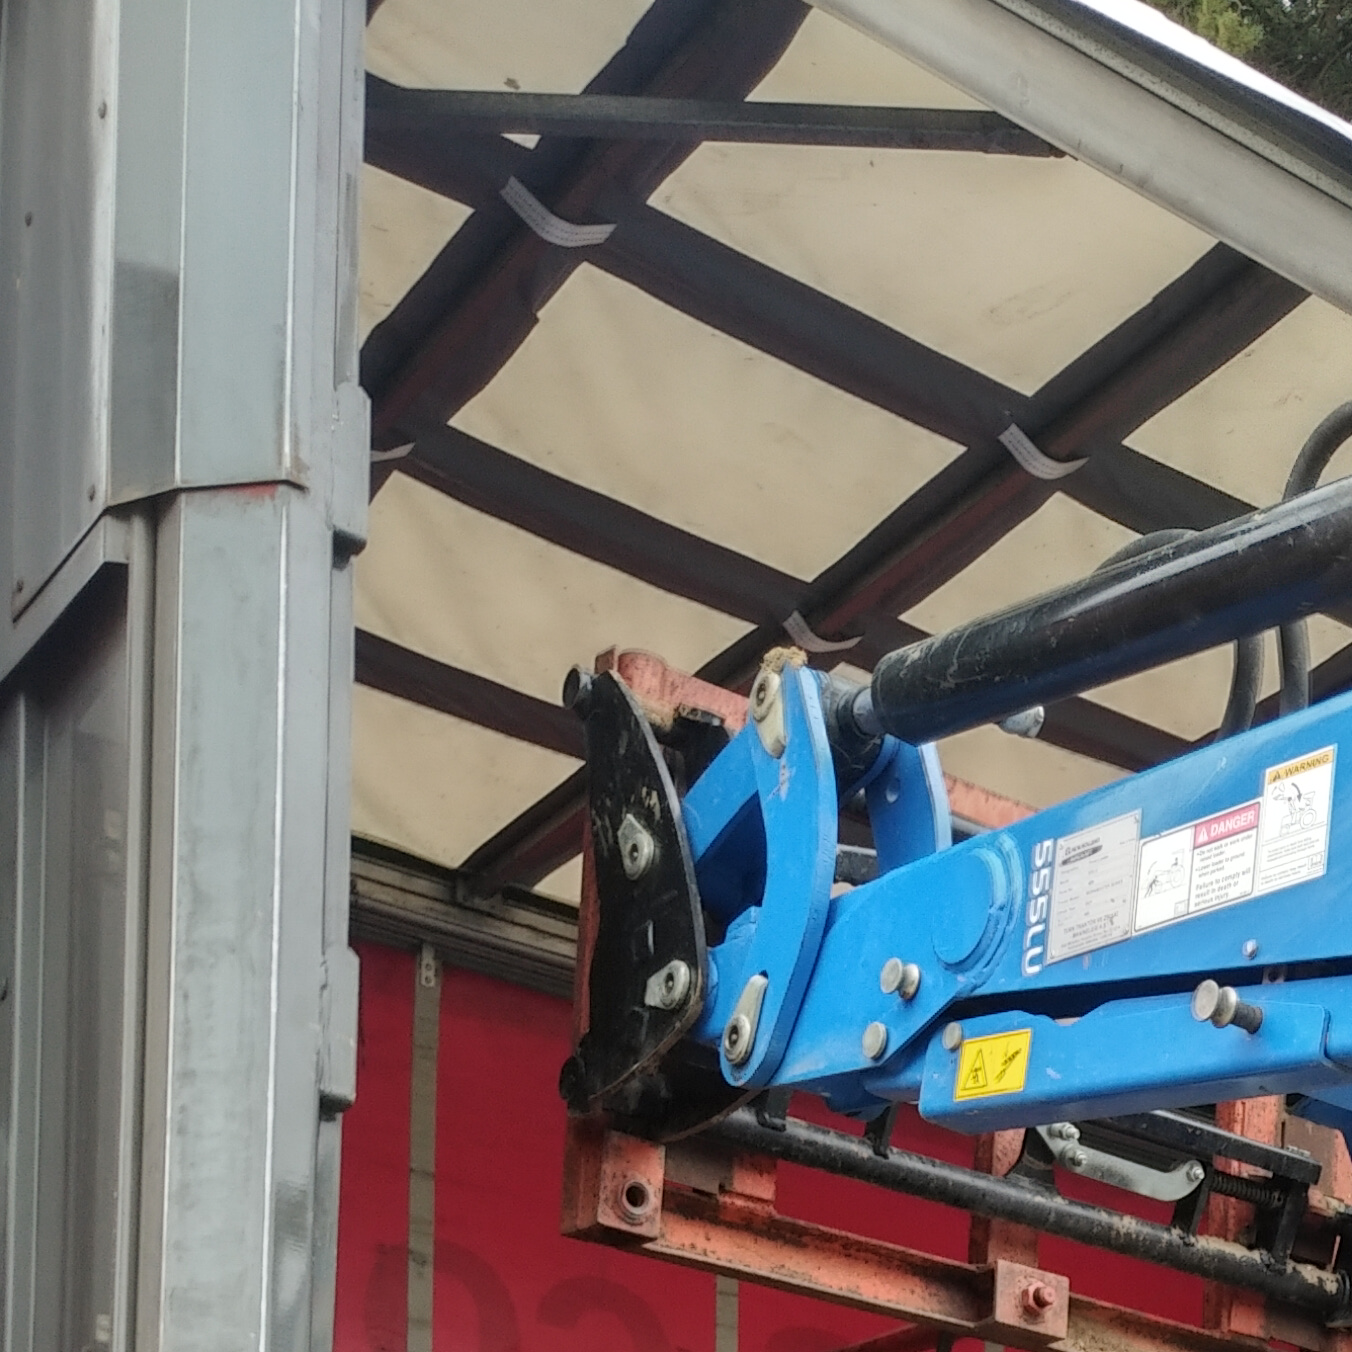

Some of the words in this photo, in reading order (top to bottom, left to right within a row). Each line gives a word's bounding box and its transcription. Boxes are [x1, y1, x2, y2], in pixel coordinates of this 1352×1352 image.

[1284, 751, 1329, 778] WARNING
[1210, 809, 1255, 837] DANGER
[1195, 879, 1213, 891] Failure
[1221, 870, 1240, 884] comply
